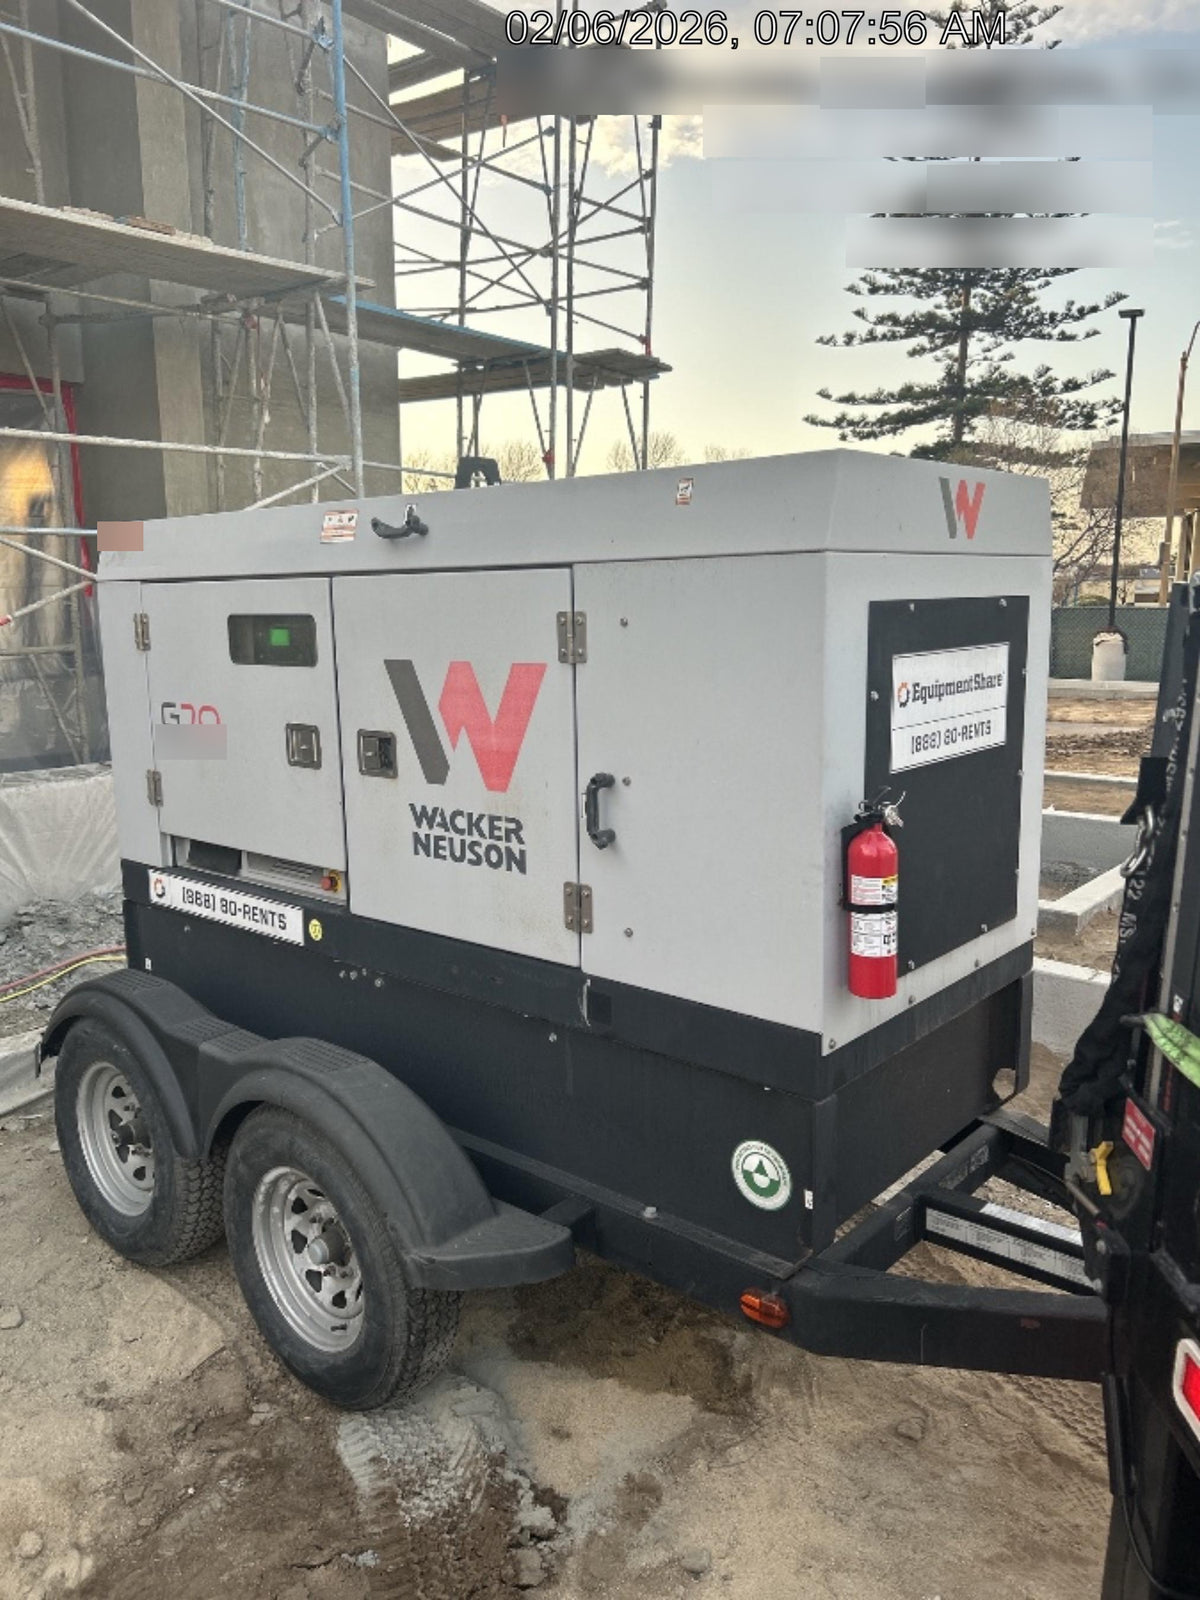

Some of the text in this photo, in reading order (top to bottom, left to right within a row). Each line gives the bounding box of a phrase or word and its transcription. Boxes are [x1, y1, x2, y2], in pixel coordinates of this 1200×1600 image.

[911, 672, 1003, 705] EquipmentShare
[943, 719, 992, 747] 80-RENTS
[408, 802, 526, 845] WACKER
[412, 831, 528, 876] NEUSON
[220, 897, 288, 931] 80-RENTS
